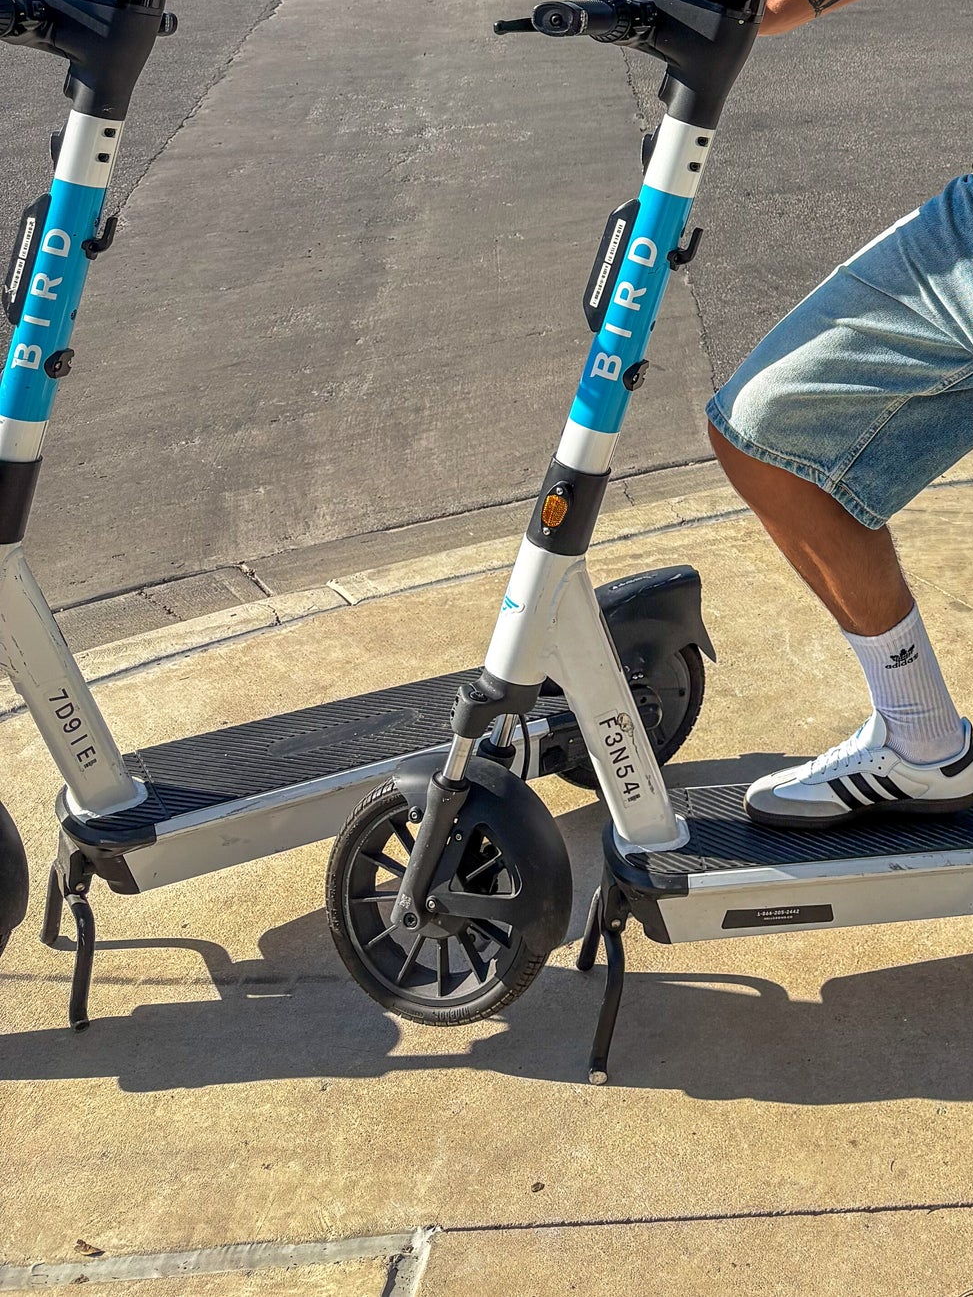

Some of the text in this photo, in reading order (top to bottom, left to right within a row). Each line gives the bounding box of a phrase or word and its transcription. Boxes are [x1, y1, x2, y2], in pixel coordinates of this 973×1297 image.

[11, 228, 72, 370] BIRD
[590, 236, 658, 381] BIRD
[885, 653, 919, 669] adidas
[599, 716, 641, 795] F3N54
